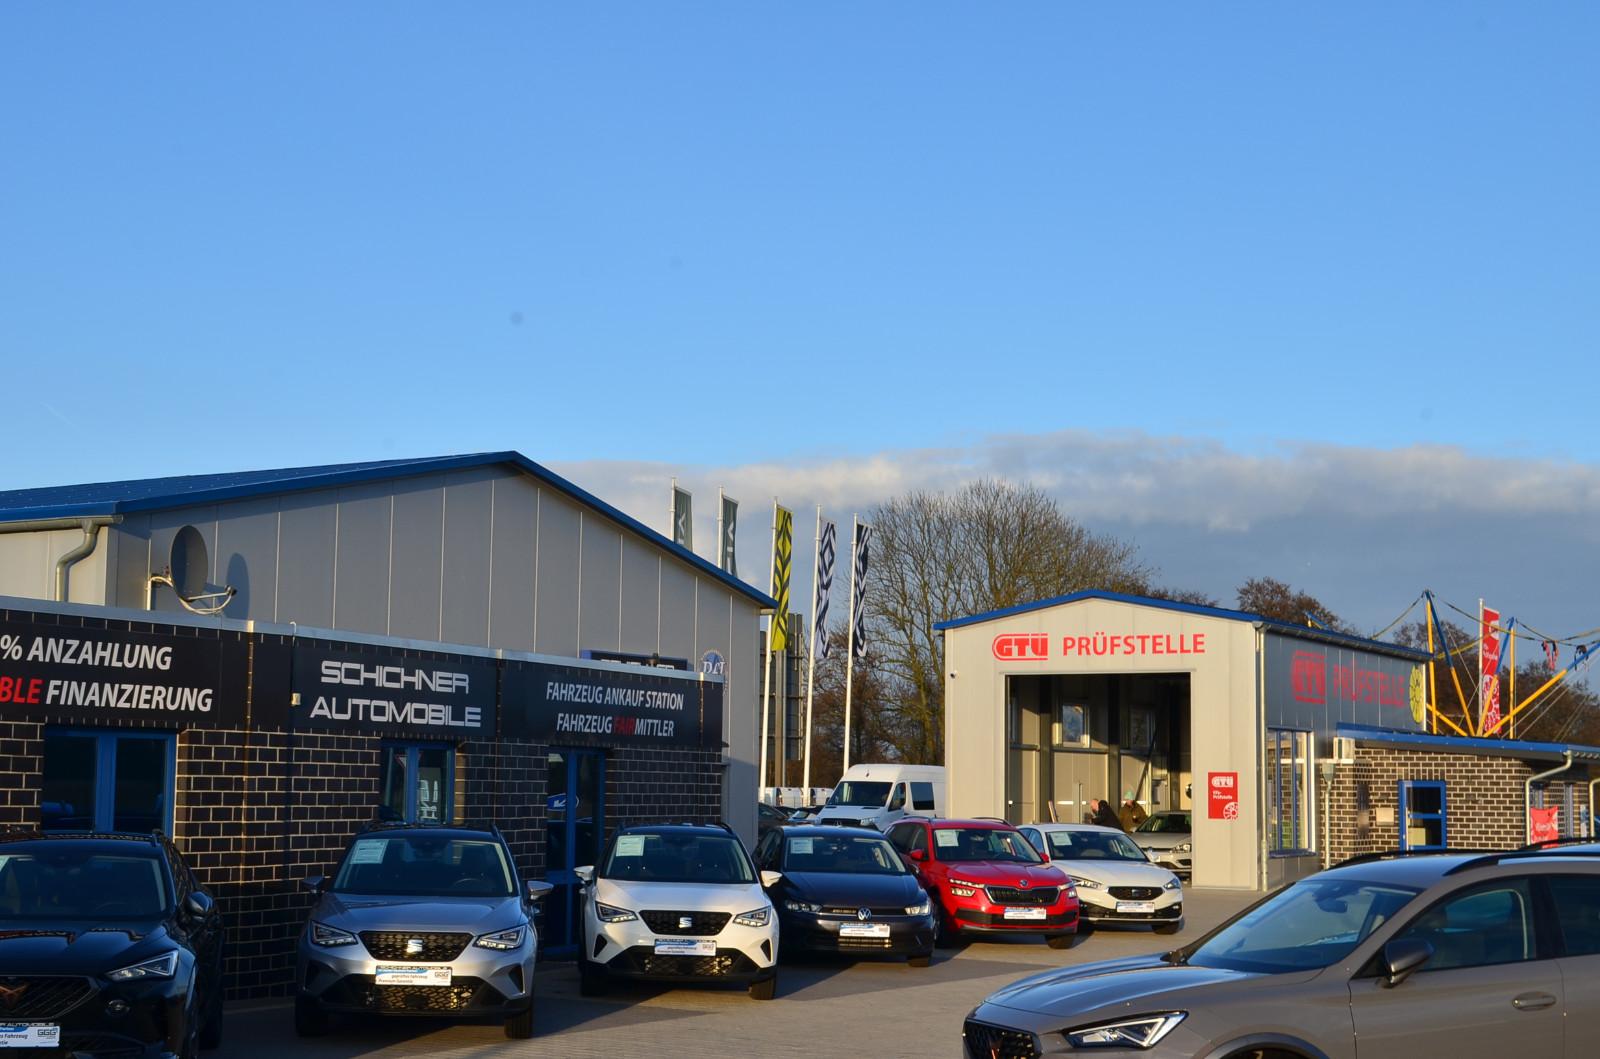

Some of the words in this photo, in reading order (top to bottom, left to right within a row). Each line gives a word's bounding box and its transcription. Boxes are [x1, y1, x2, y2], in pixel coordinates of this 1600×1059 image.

[27, 637, 172, 670] ANZAHLUNG
[992, 633, 1048, 661] GTÜ
[1063, 632, 1205, 656] PRÜFSTELLE
[321, 660, 469, 694] SCHICHNER
[46, 680, 213, 712] FINANZIERUNG
[310, 696, 481, 728] AUTOMOBILE
[546, 682, 603, 703] FAHRZEUG
[604, 687, 644, 707] ANKAUF
[645, 691, 684, 710] STATION
[557, 713, 613, 734] FAHRZEUG
